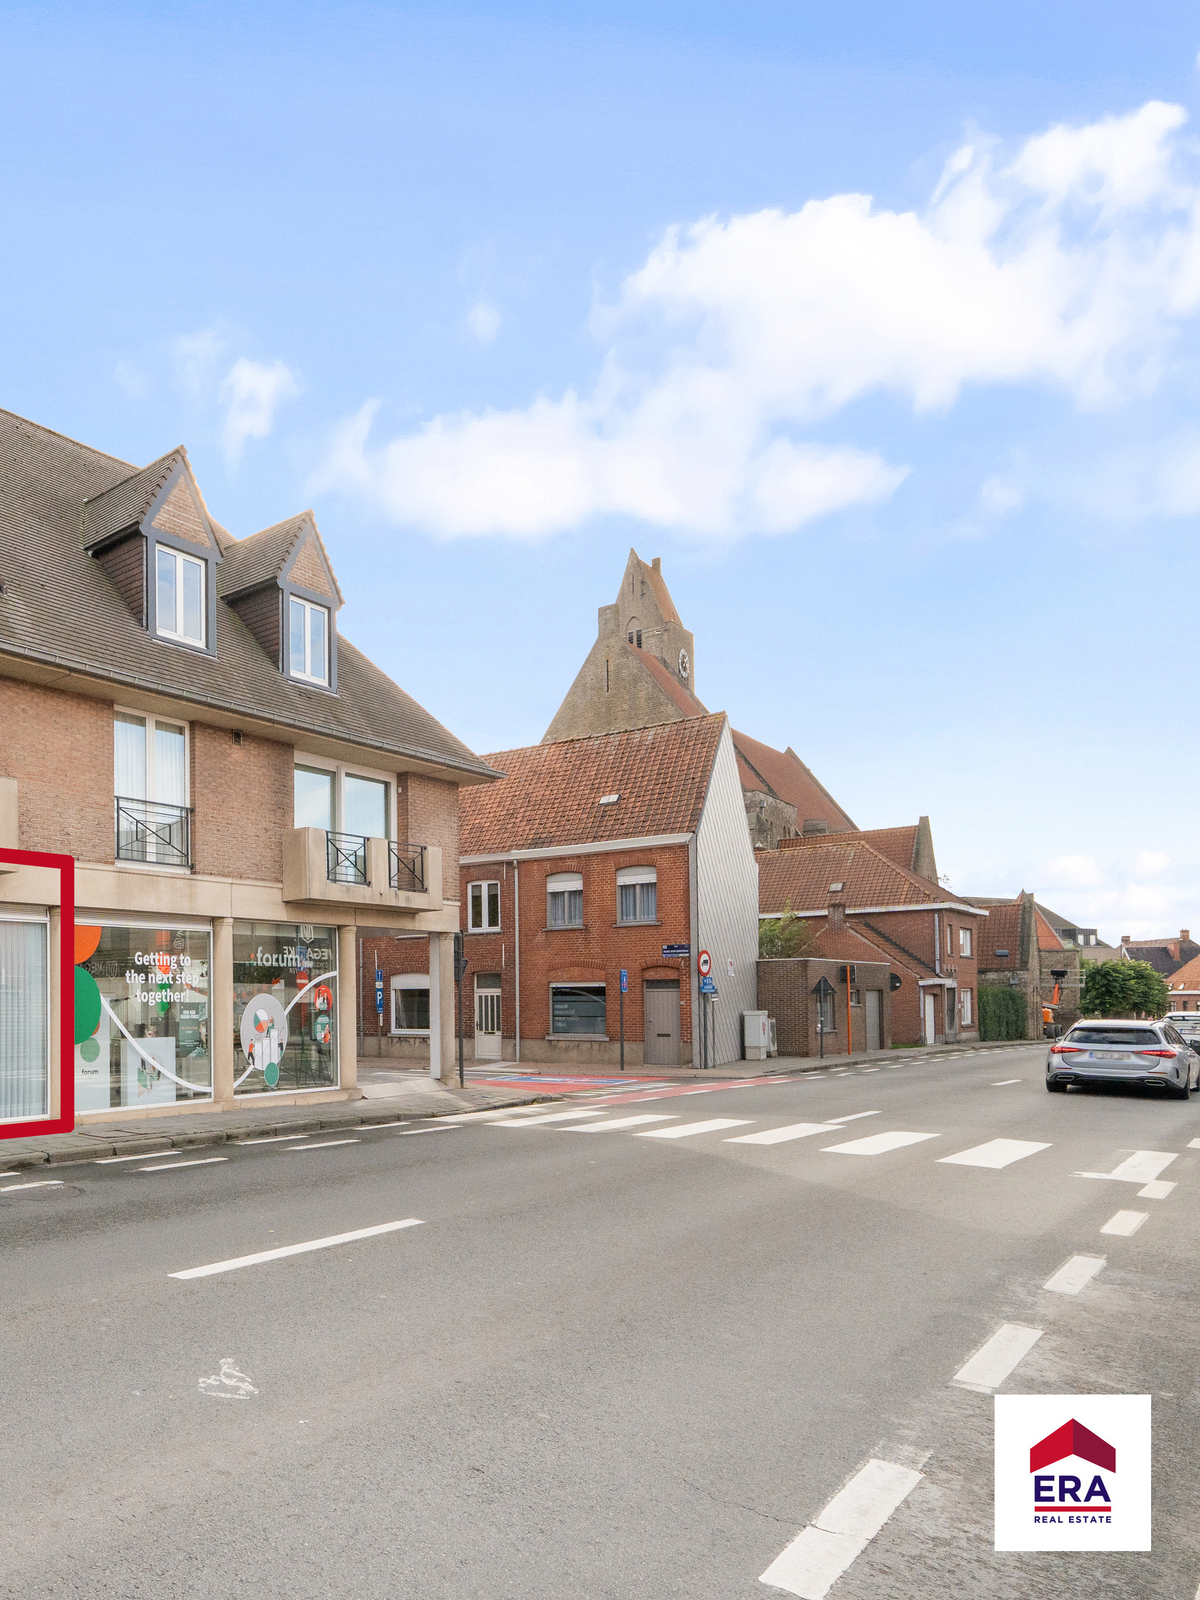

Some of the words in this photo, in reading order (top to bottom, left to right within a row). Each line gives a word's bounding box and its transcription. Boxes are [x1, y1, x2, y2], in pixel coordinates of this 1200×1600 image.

[134, 951, 178, 970] Getting
[179, 953, 191, 967] to
[256, 946, 300, 967] forum
[125, 969, 146, 984] the
[148, 971, 174, 984] next
[175, 971, 199, 987] step
[136, 988, 189, 1006] together!
[377, 991, 383, 1005] P
